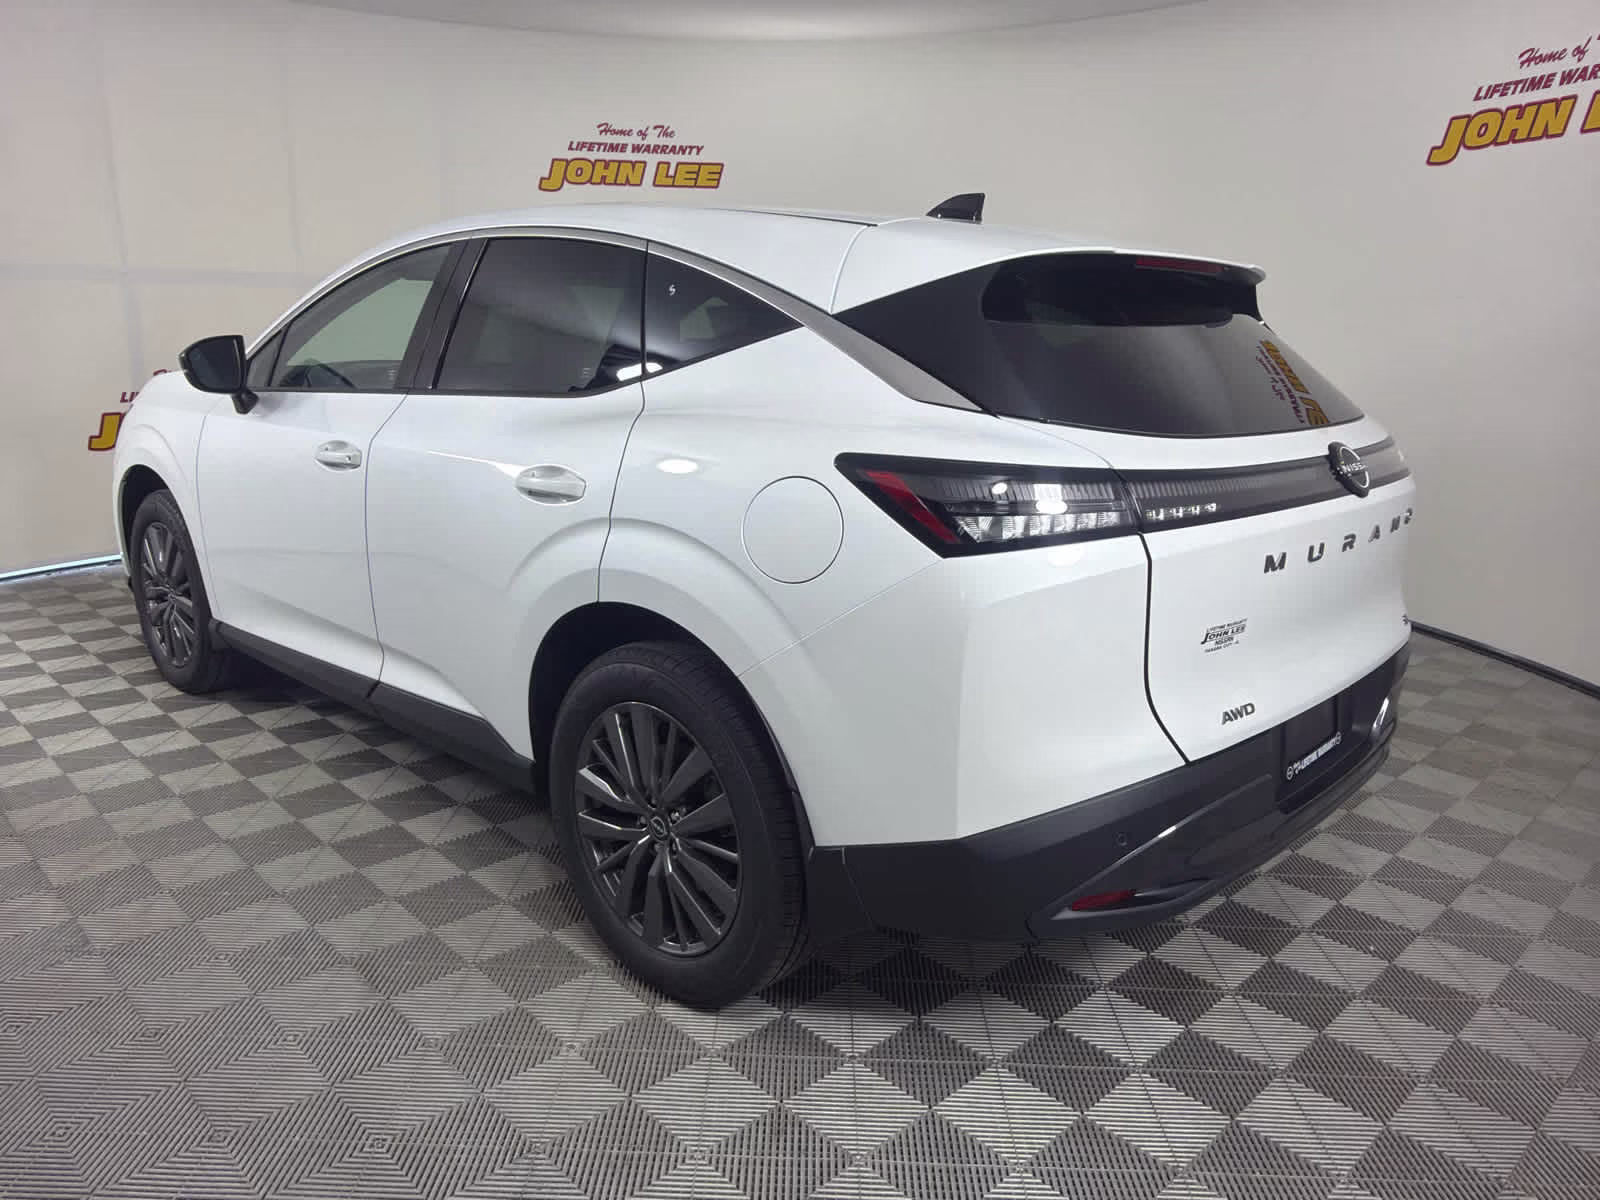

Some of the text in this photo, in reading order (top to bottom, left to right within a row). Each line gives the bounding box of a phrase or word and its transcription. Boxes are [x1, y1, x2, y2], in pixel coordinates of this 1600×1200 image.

[1518, 35, 1592, 69] Home of
[1473, 72, 1557, 101] LIFETIME
[597, 122, 676, 141] Home of The
[1426, 94, 1578, 166] JOHN
[567, 141, 704, 155] LIFETIME WARRANTY
[538, 158, 724, 192] JOHN LEE
[1200, 629, 1230, 645] JOHN
[1221, 702, 1256, 725] AWD
